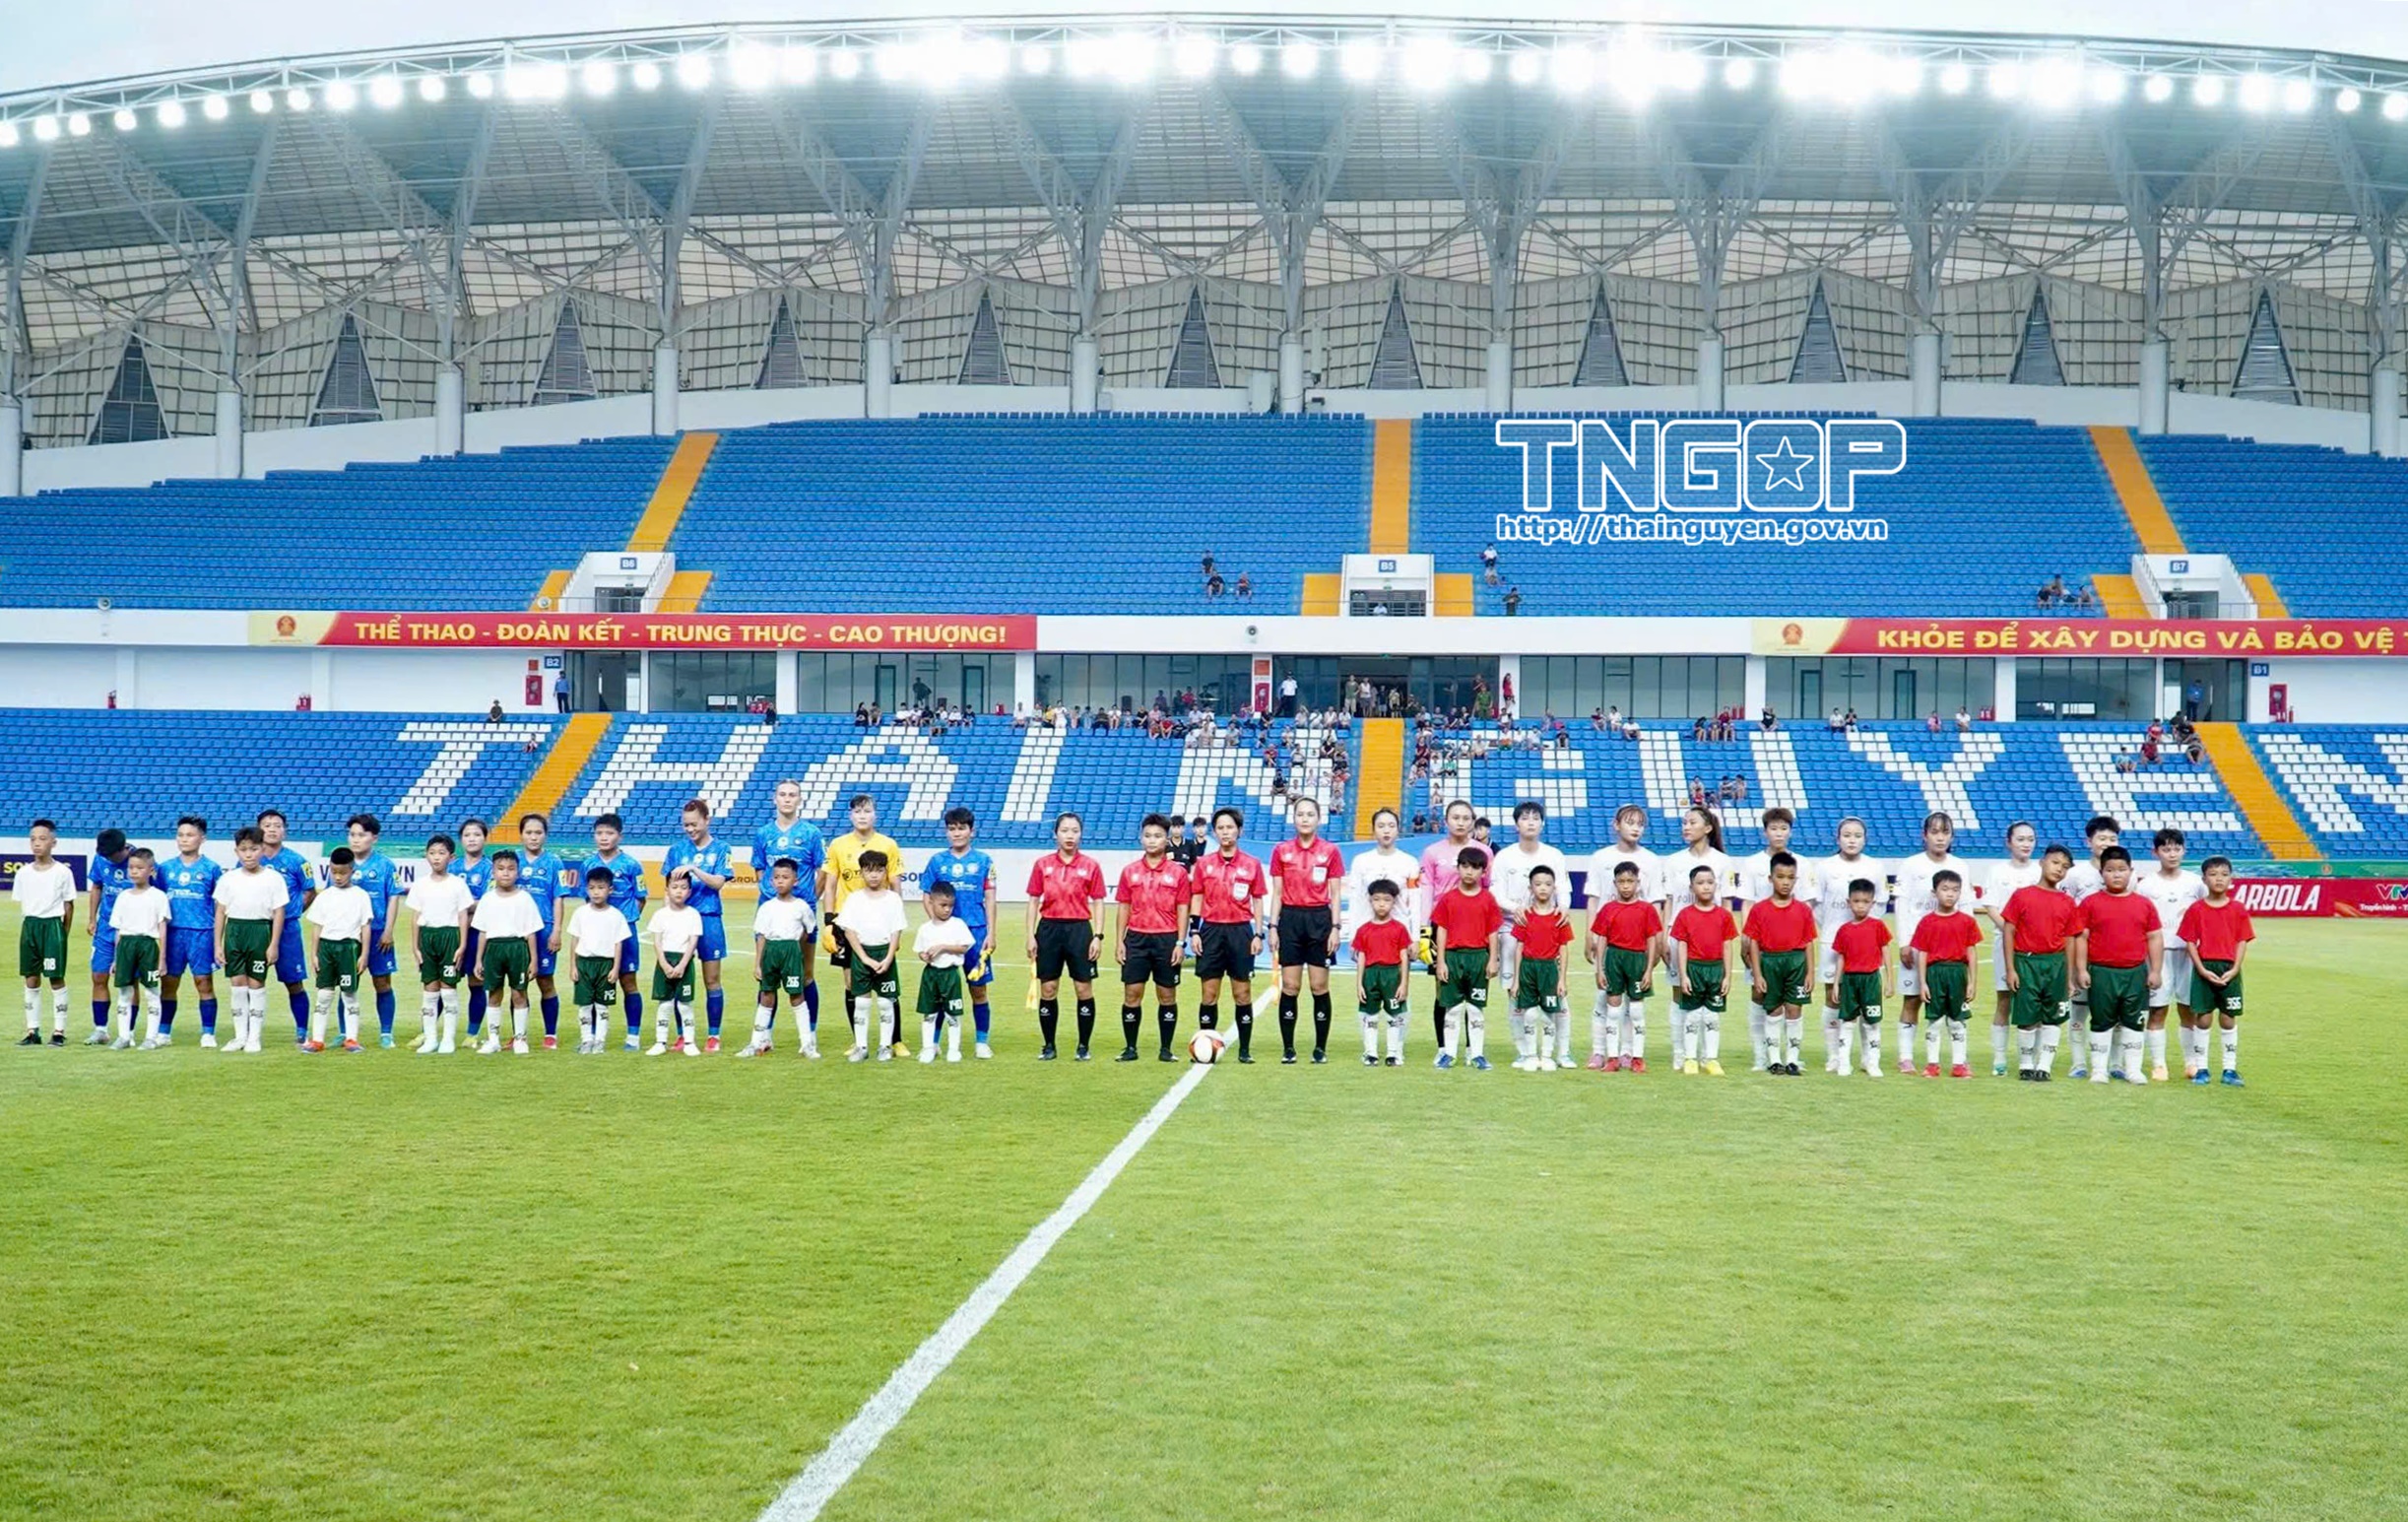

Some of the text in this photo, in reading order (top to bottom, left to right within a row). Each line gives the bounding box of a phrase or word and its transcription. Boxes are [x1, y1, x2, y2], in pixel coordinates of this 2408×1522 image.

[621, 559, 635, 568] B6
[1380, 561, 1395, 571] B5
[2172, 562, 2186, 571] B7
[354, 614, 401, 639] THỂ
[408, 623, 476, 640] THAO
[496, 620, 570, 641] ĐOÀN
[578, 617, 624, 641] KẾT
[645, 624, 732, 642] TRUNG
[739, 623, 807, 647] THỰC
[828, 625, 883, 643] CAO
[889, 624, 1007, 648] THƯỢNG!
[1877, 623, 1965, 648] KHỎE
[1974, 621, 2019, 649] ĐỂ
[2028, 626, 2100, 649] XÂY
[2110, 628, 2207, 654] DỰNG
[2216, 627, 2264, 650] VÀ
[2274, 624, 2344, 650] BẢO
[2353, 627, 2394, 654] VỆ
[546, 657, 559, 667] B2
[2253, 665, 2268, 675] B1
[2228, 884, 2321, 911] ARBOLA
